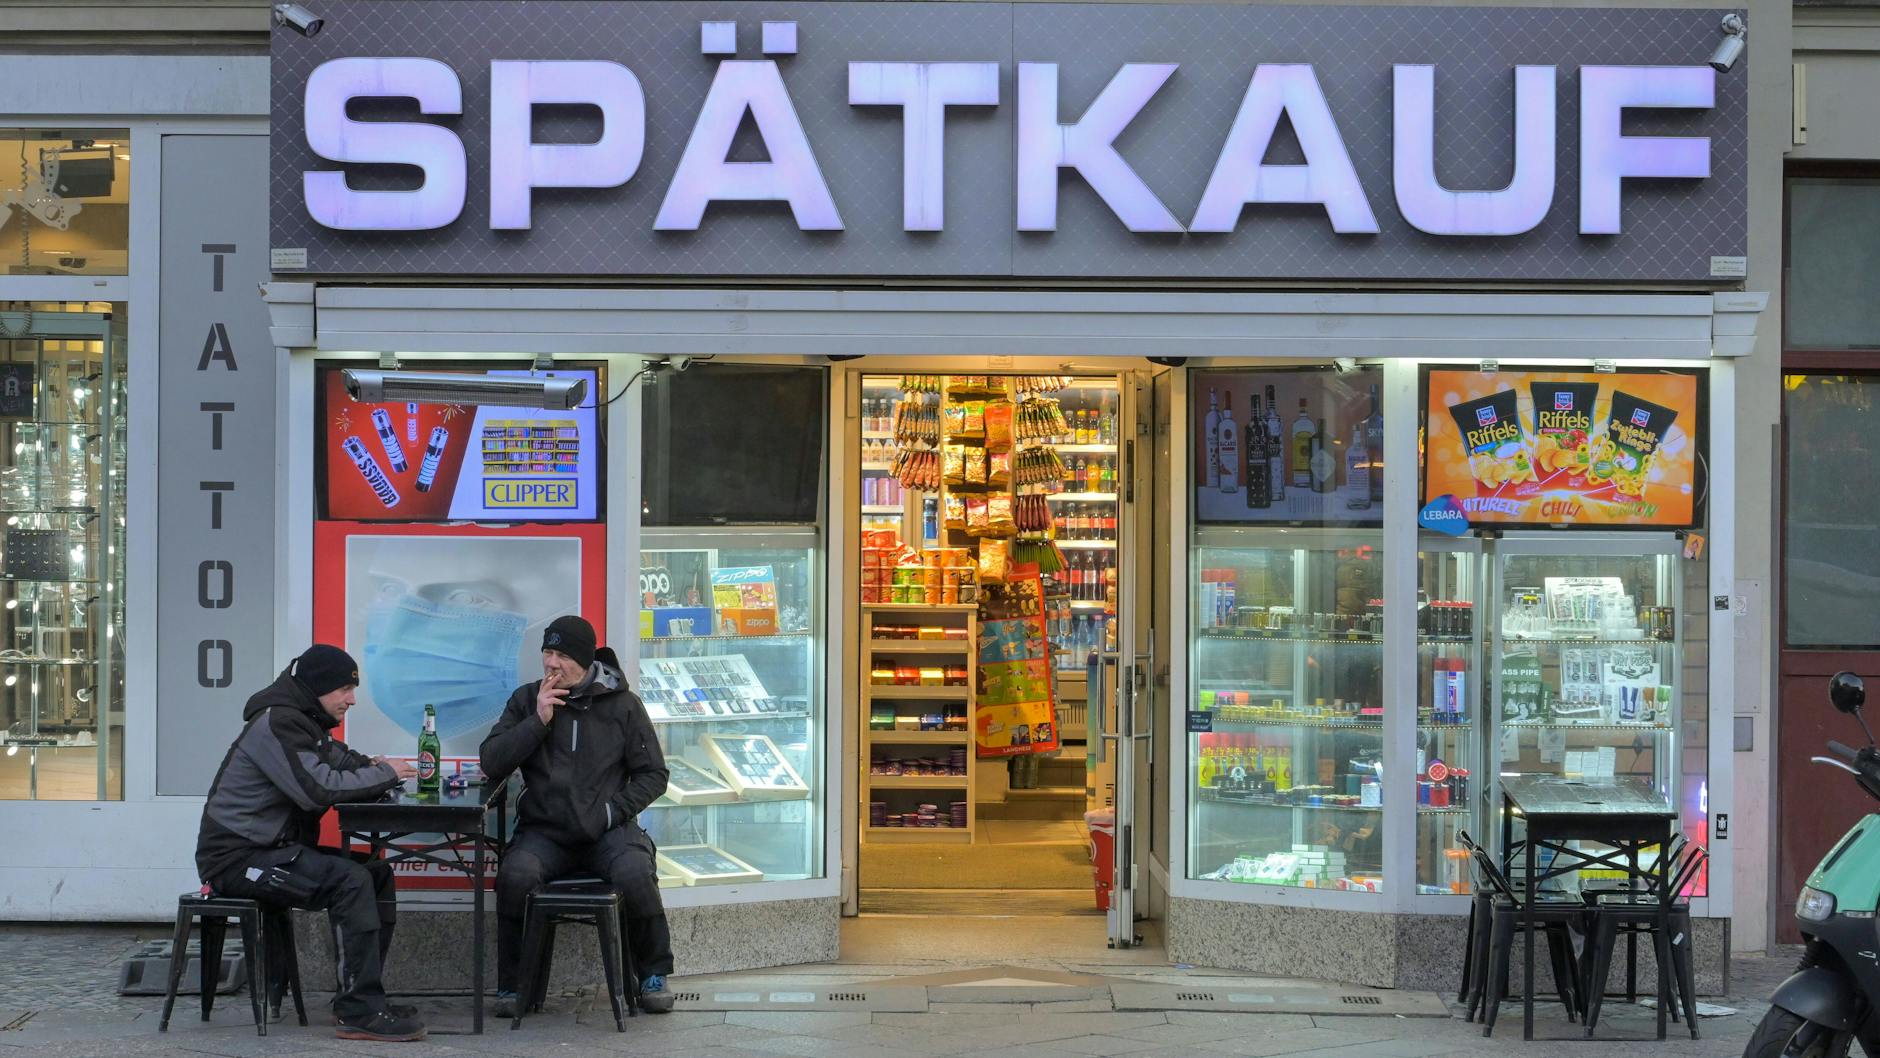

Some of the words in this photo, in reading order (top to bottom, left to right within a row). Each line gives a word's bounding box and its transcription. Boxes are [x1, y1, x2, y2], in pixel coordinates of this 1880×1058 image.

[303, 19, 1717, 237] SPÄTKAUF
[1539, 410, 1590, 428] Riffels
[1467, 421, 1519, 448] Riffels
[197, 244, 239, 689] TATTOO
[358, 458, 397, 505] BADASS
[491, 484, 569, 502] CLIPPER
[1424, 510, 1463, 520] LEBARA
[1460, 497, 1521, 516] ATURELL
[1540, 501, 1583, 517] CHILI
[718, 567, 768, 583] zippo
[747, 618, 769, 627] zippo
